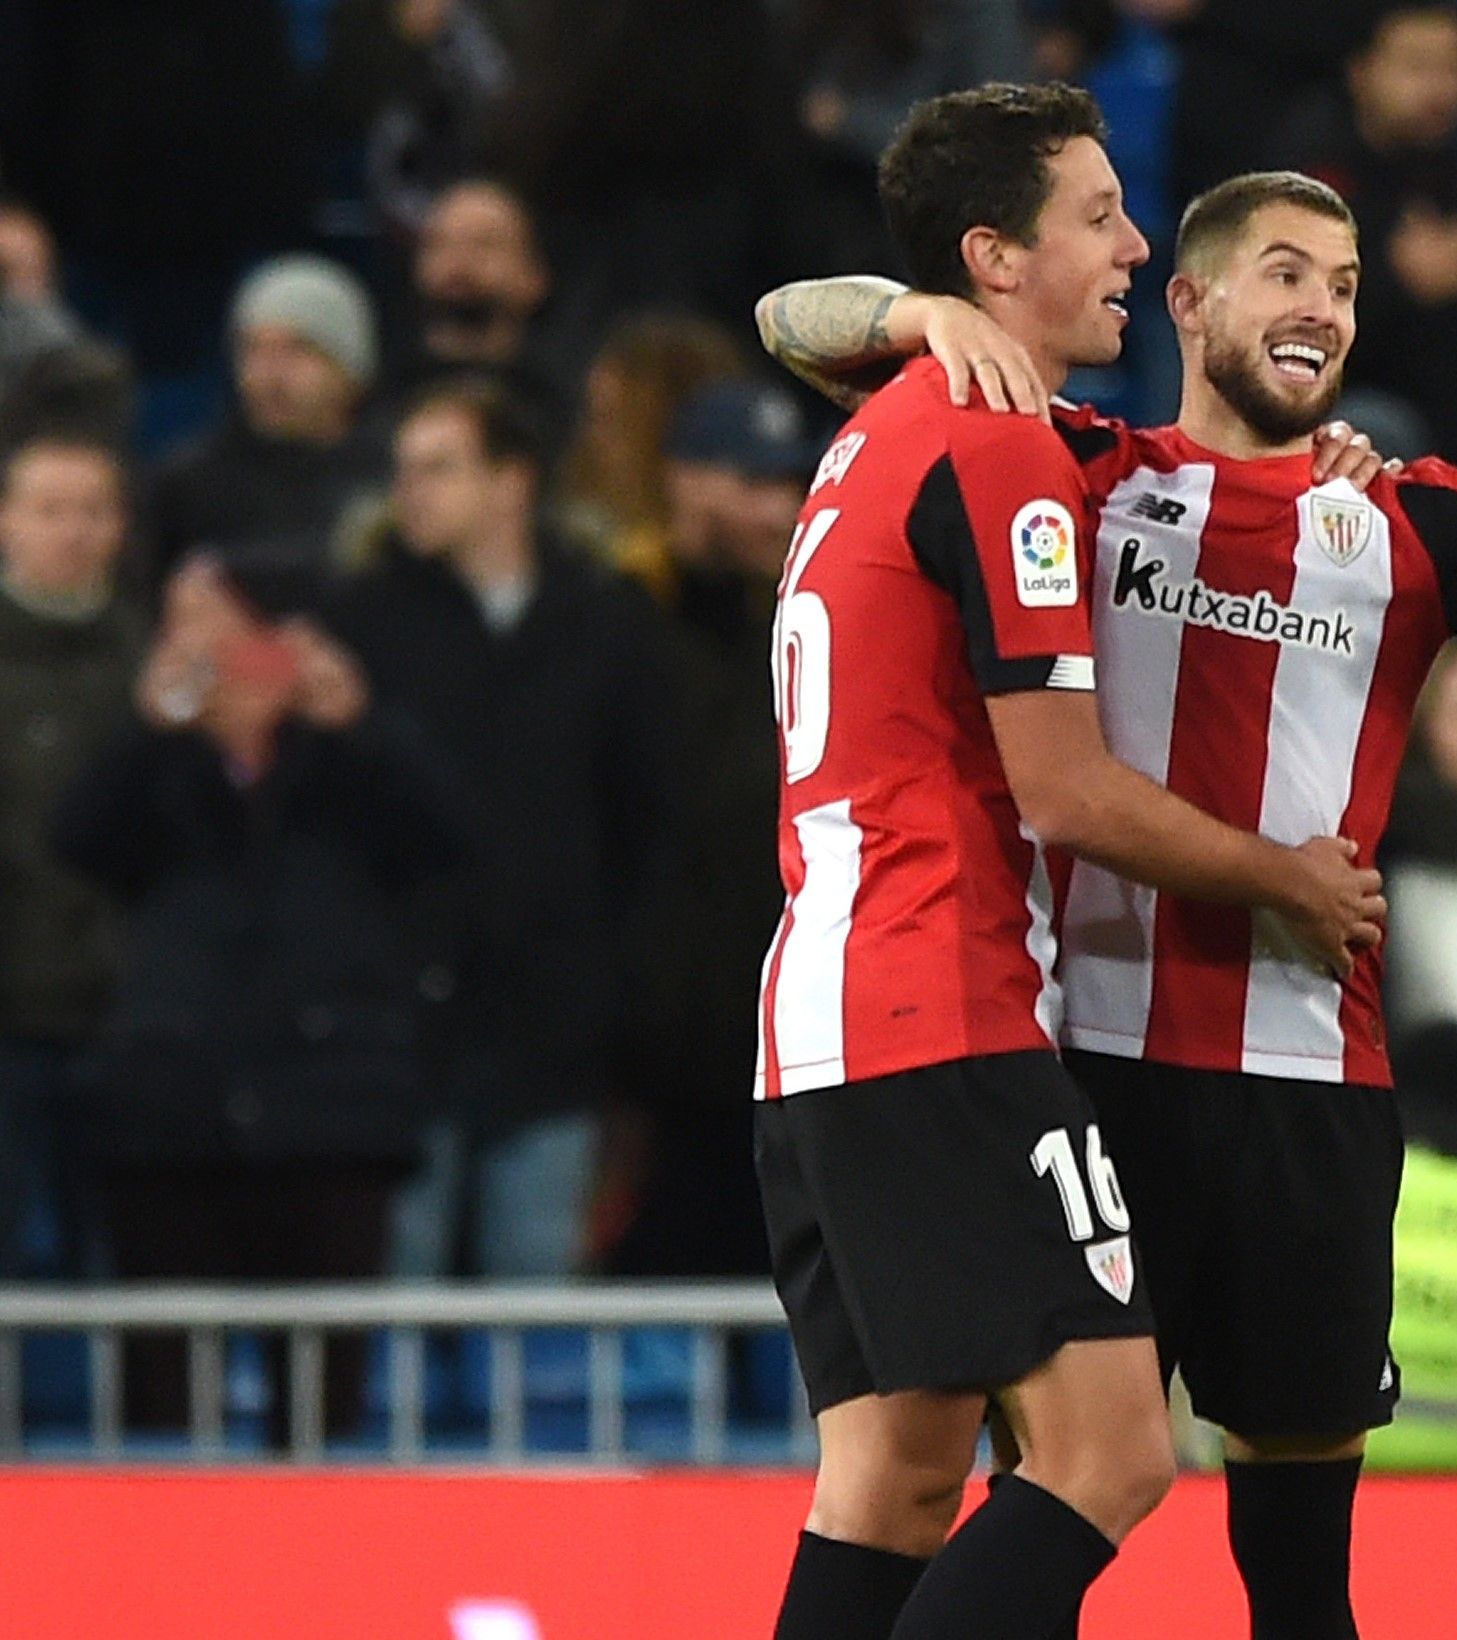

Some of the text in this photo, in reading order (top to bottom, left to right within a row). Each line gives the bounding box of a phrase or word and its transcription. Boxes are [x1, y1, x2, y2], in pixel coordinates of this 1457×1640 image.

[1023, 577, 1071, 593] LaLiga
[1113, 538, 1354, 653] Kutxabank
[1029, 1123, 1131, 1242] 16
